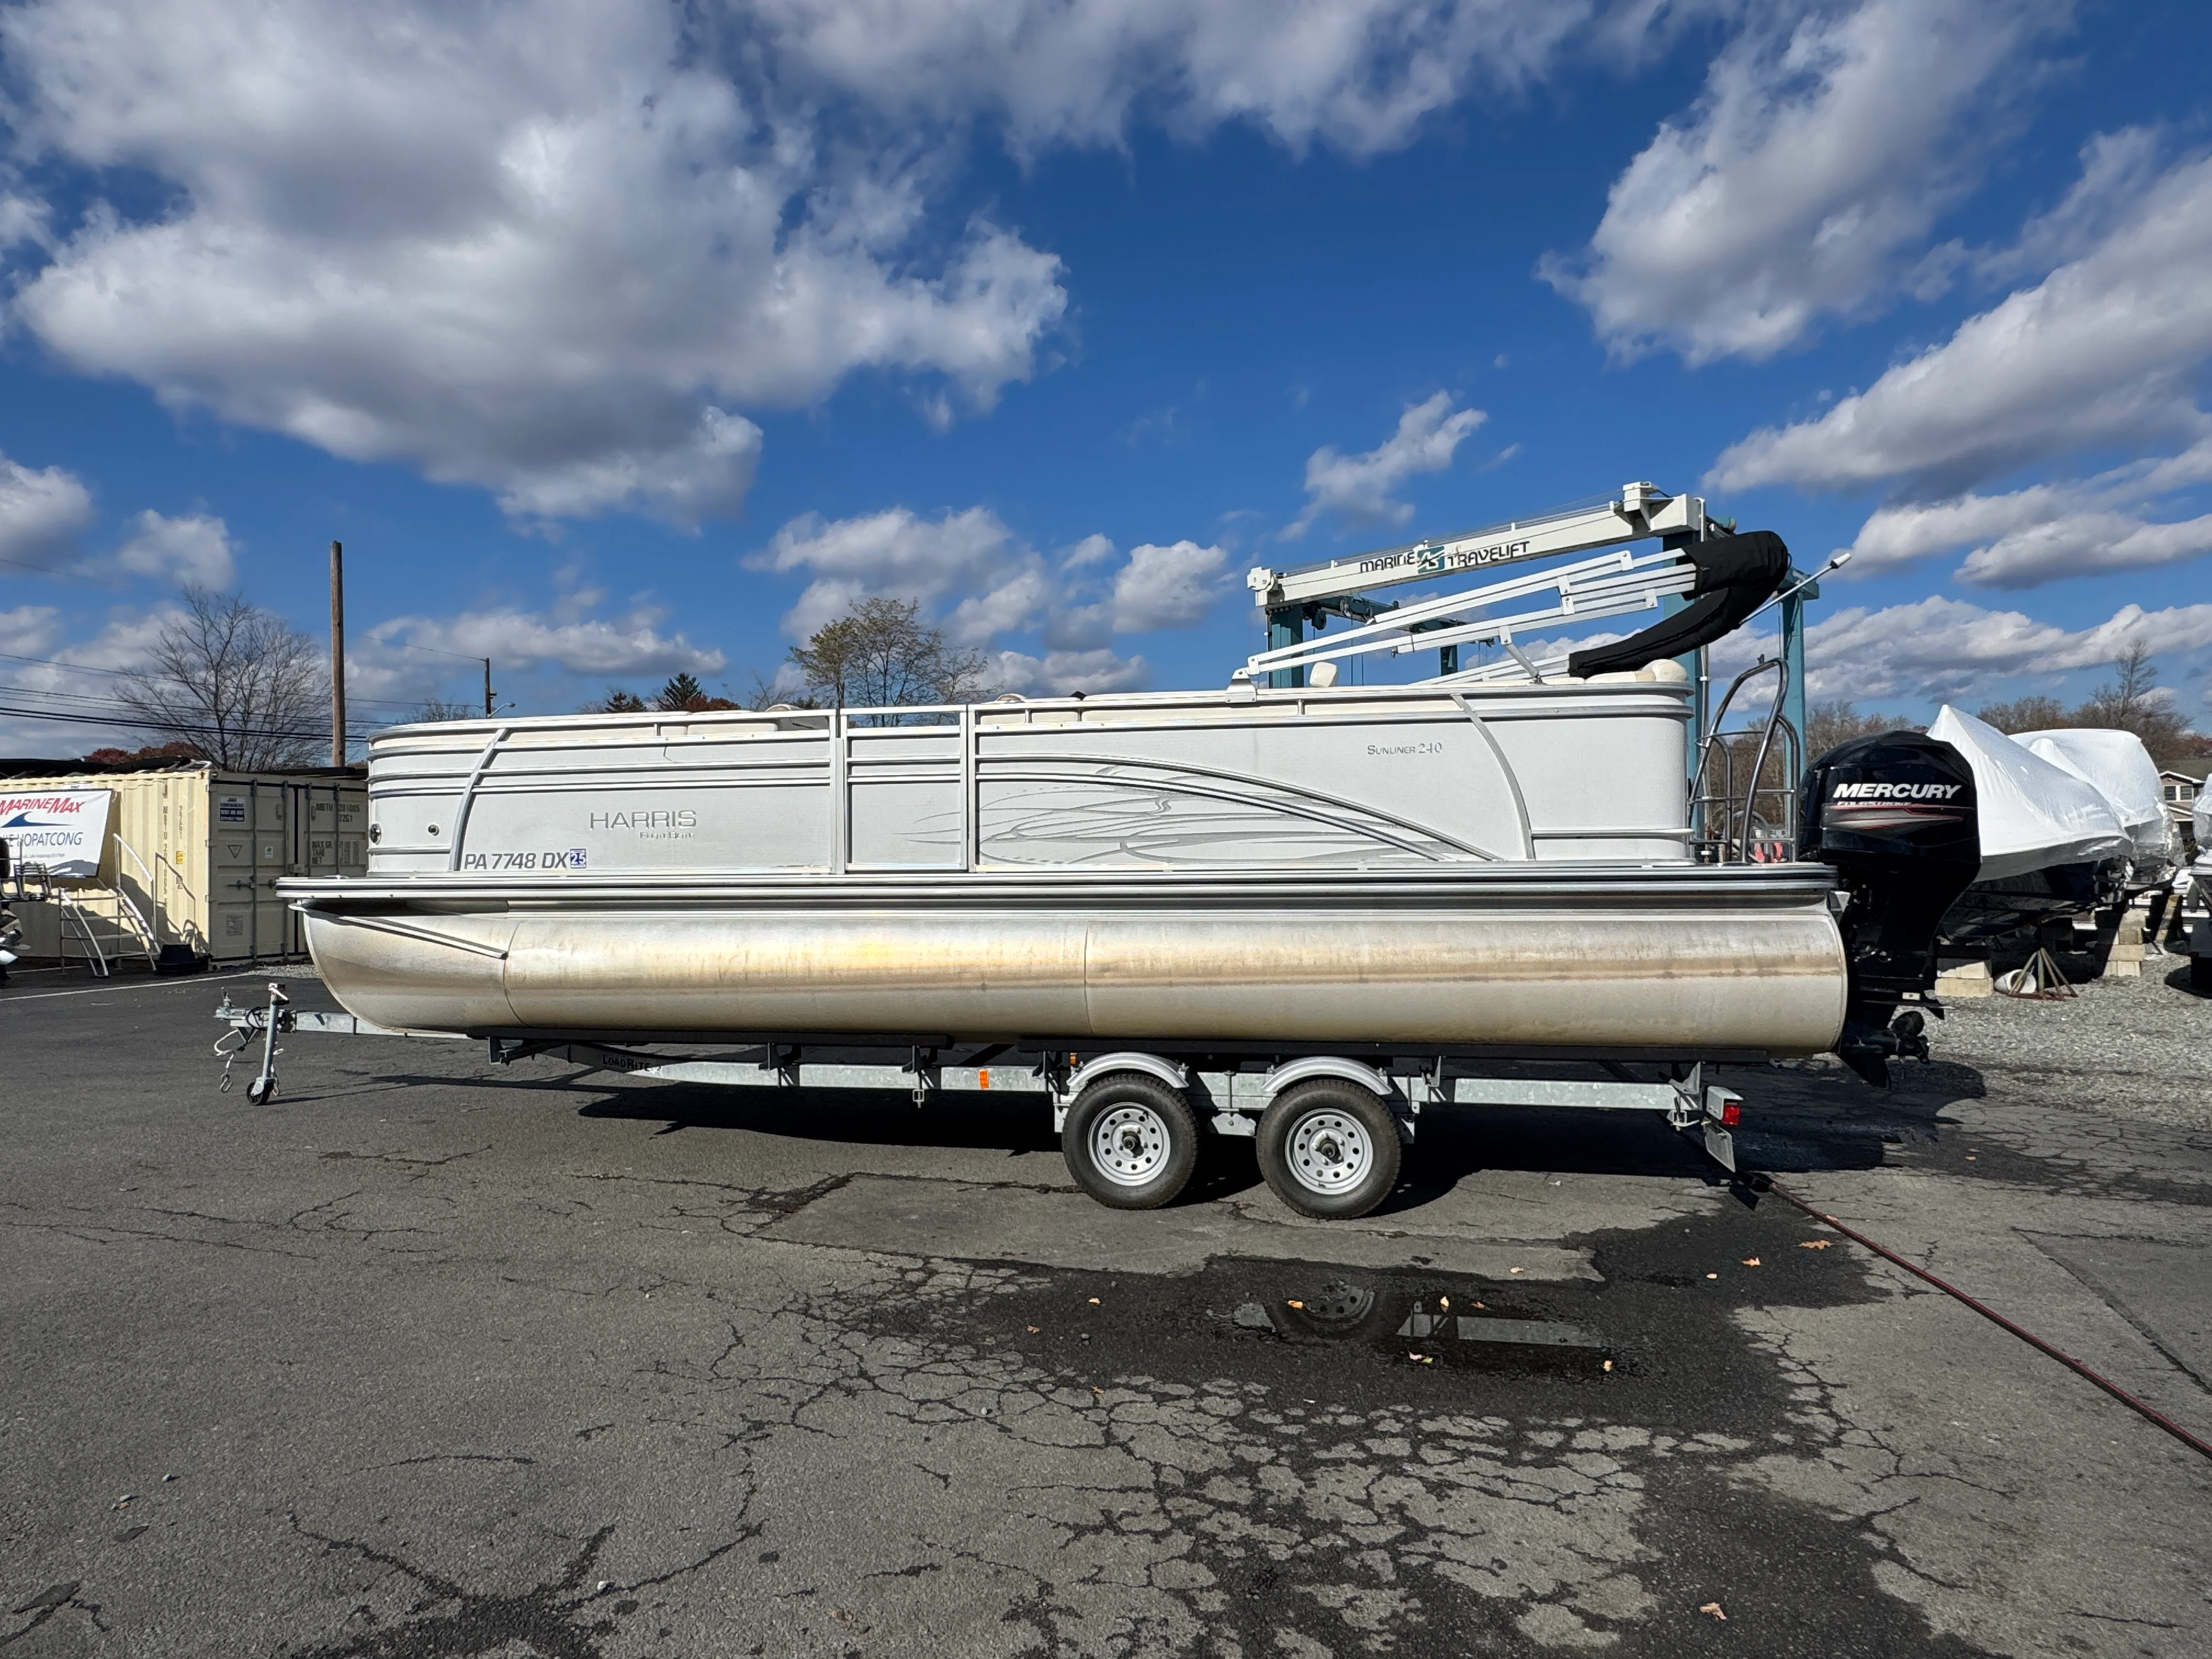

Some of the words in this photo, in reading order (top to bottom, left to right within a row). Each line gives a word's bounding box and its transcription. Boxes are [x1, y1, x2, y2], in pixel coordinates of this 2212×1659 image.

[1361, 551, 1416, 573] MARINE
[1447, 541, 1530, 567] TRAVELIFT
[1418, 742, 1443, 754] 240
[1833, 783, 1962, 798] MERCURY
[590, 810, 697, 829] HARRIS
[464, 854, 487, 870] PA
[492, 853, 536, 869] 7748
[541, 852, 569, 868] DX
[571, 853, 586, 865] 25
